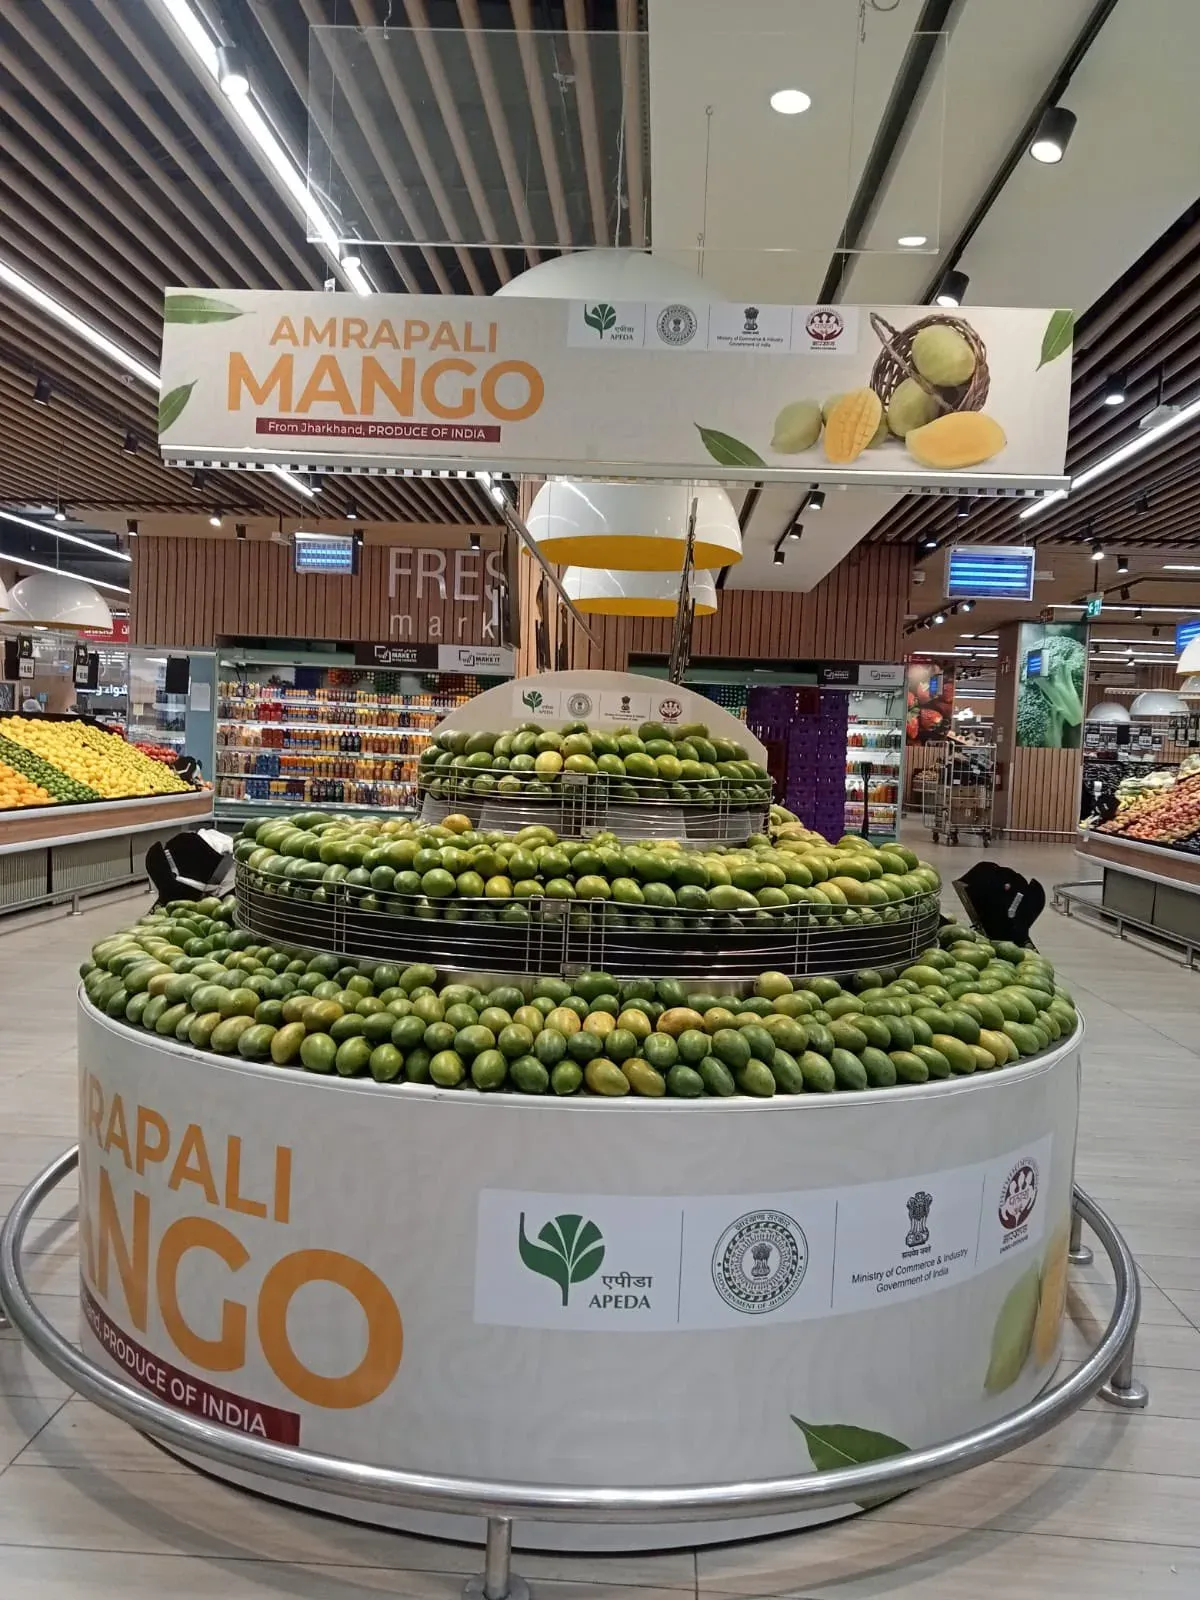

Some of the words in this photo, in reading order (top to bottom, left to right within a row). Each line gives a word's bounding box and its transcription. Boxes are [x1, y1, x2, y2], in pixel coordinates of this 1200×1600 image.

[269, 315, 498, 353] AMRAPALI
[228, 351, 545, 422] MANGO
[268, 422, 299, 434] From
[301, 422, 365, 437] Jharkhand,
[368, 425, 428, 438] PRODUCE
[431, 427, 448, 439] OF
[451, 427, 486, 440] INDIA
[601, 1271, 653, 1290] एपीडा
[851, 1271, 885, 1285] Ministry
[886, 1268, 895, 1278] of
[895, 1259, 935, 1276] Commerce
[936, 1256, 943, 1265] &
[943, 1249, 969, 1264] Industry
[876, 1275, 924, 1294] Government
[924, 1271, 933, 1282] of
[933, 1267, 949, 1280] India
[588, 1294, 652, 1310] APEDA
[103, 1323, 167, 1393] PRODUCE
[171, 1377, 198, 1407] OF
[202, 1392, 268, 1438] INDIA
